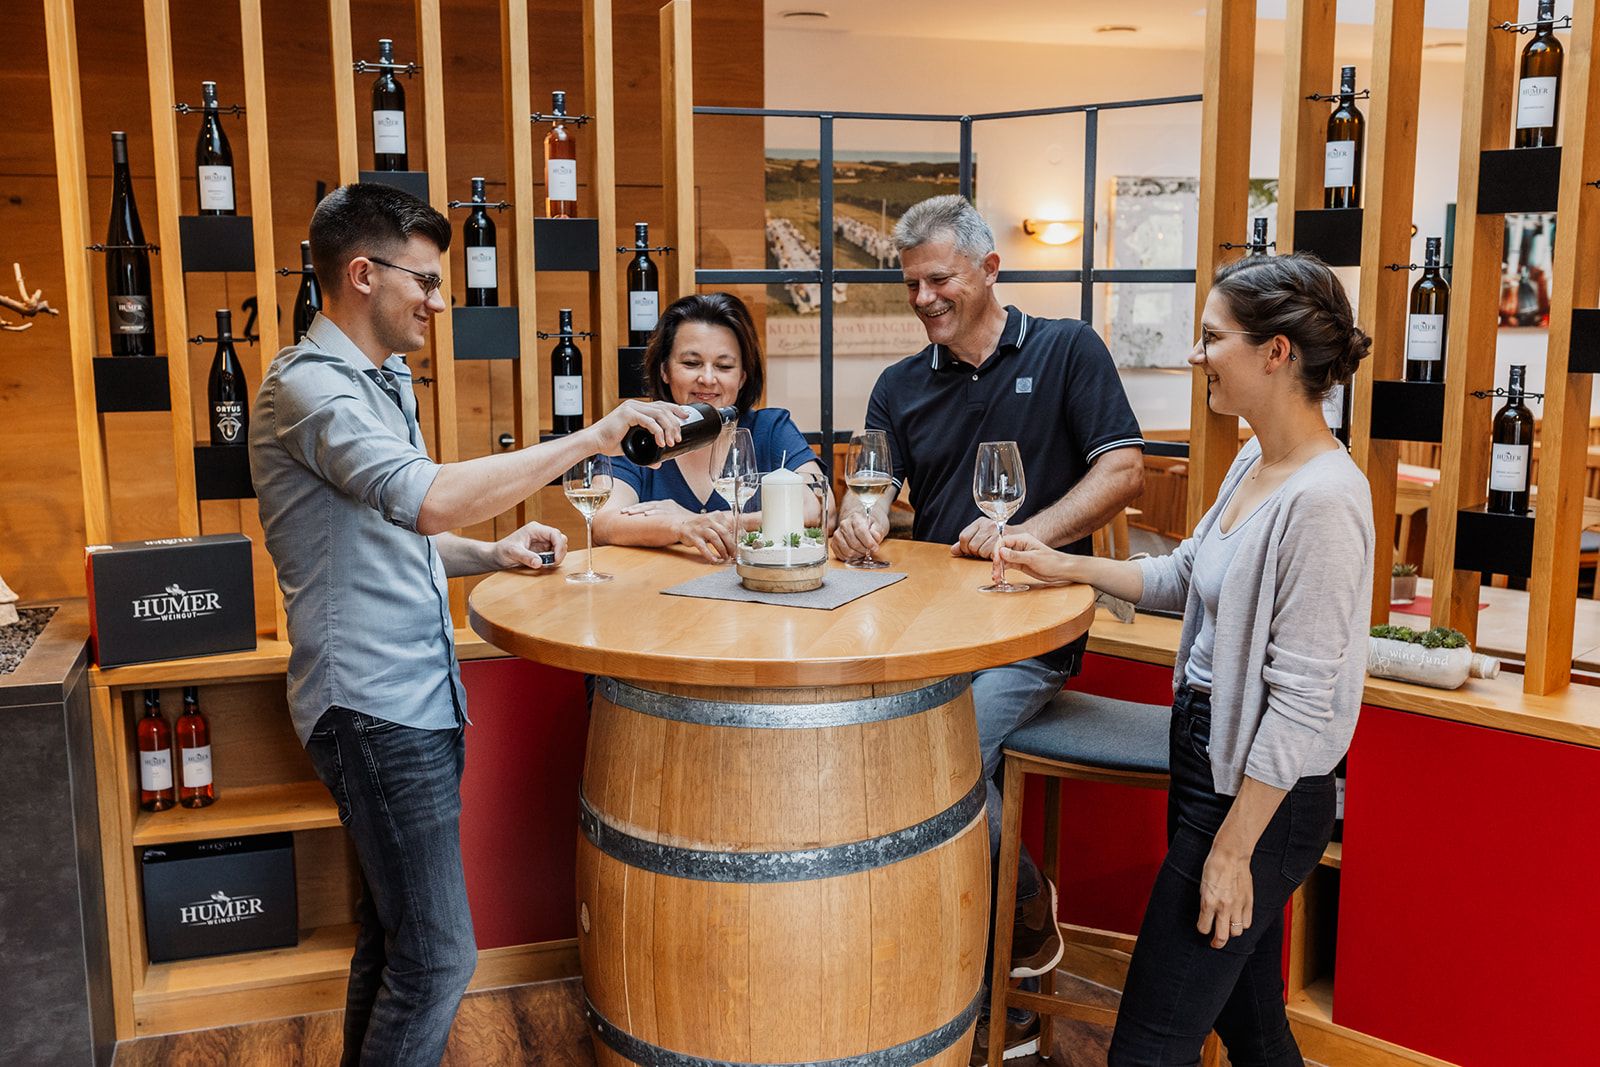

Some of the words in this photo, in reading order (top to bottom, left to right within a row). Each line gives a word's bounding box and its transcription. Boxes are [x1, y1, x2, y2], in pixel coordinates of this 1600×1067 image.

[1522, 87, 1549, 95] HUMER
[768, 322, 839, 336] KULINAK
[215, 405, 241, 413] ORTUS
[1496, 453, 1522, 462] HUMER
[132, 593, 222, 618] HUMER
[160, 612, 198, 621] WEINGUT
[1390, 648, 1416, 662] wine
[1418, 651, 1450, 666] fund
[180, 898, 265, 924] HUMER
[206, 916, 242, 926] WEINGUT
